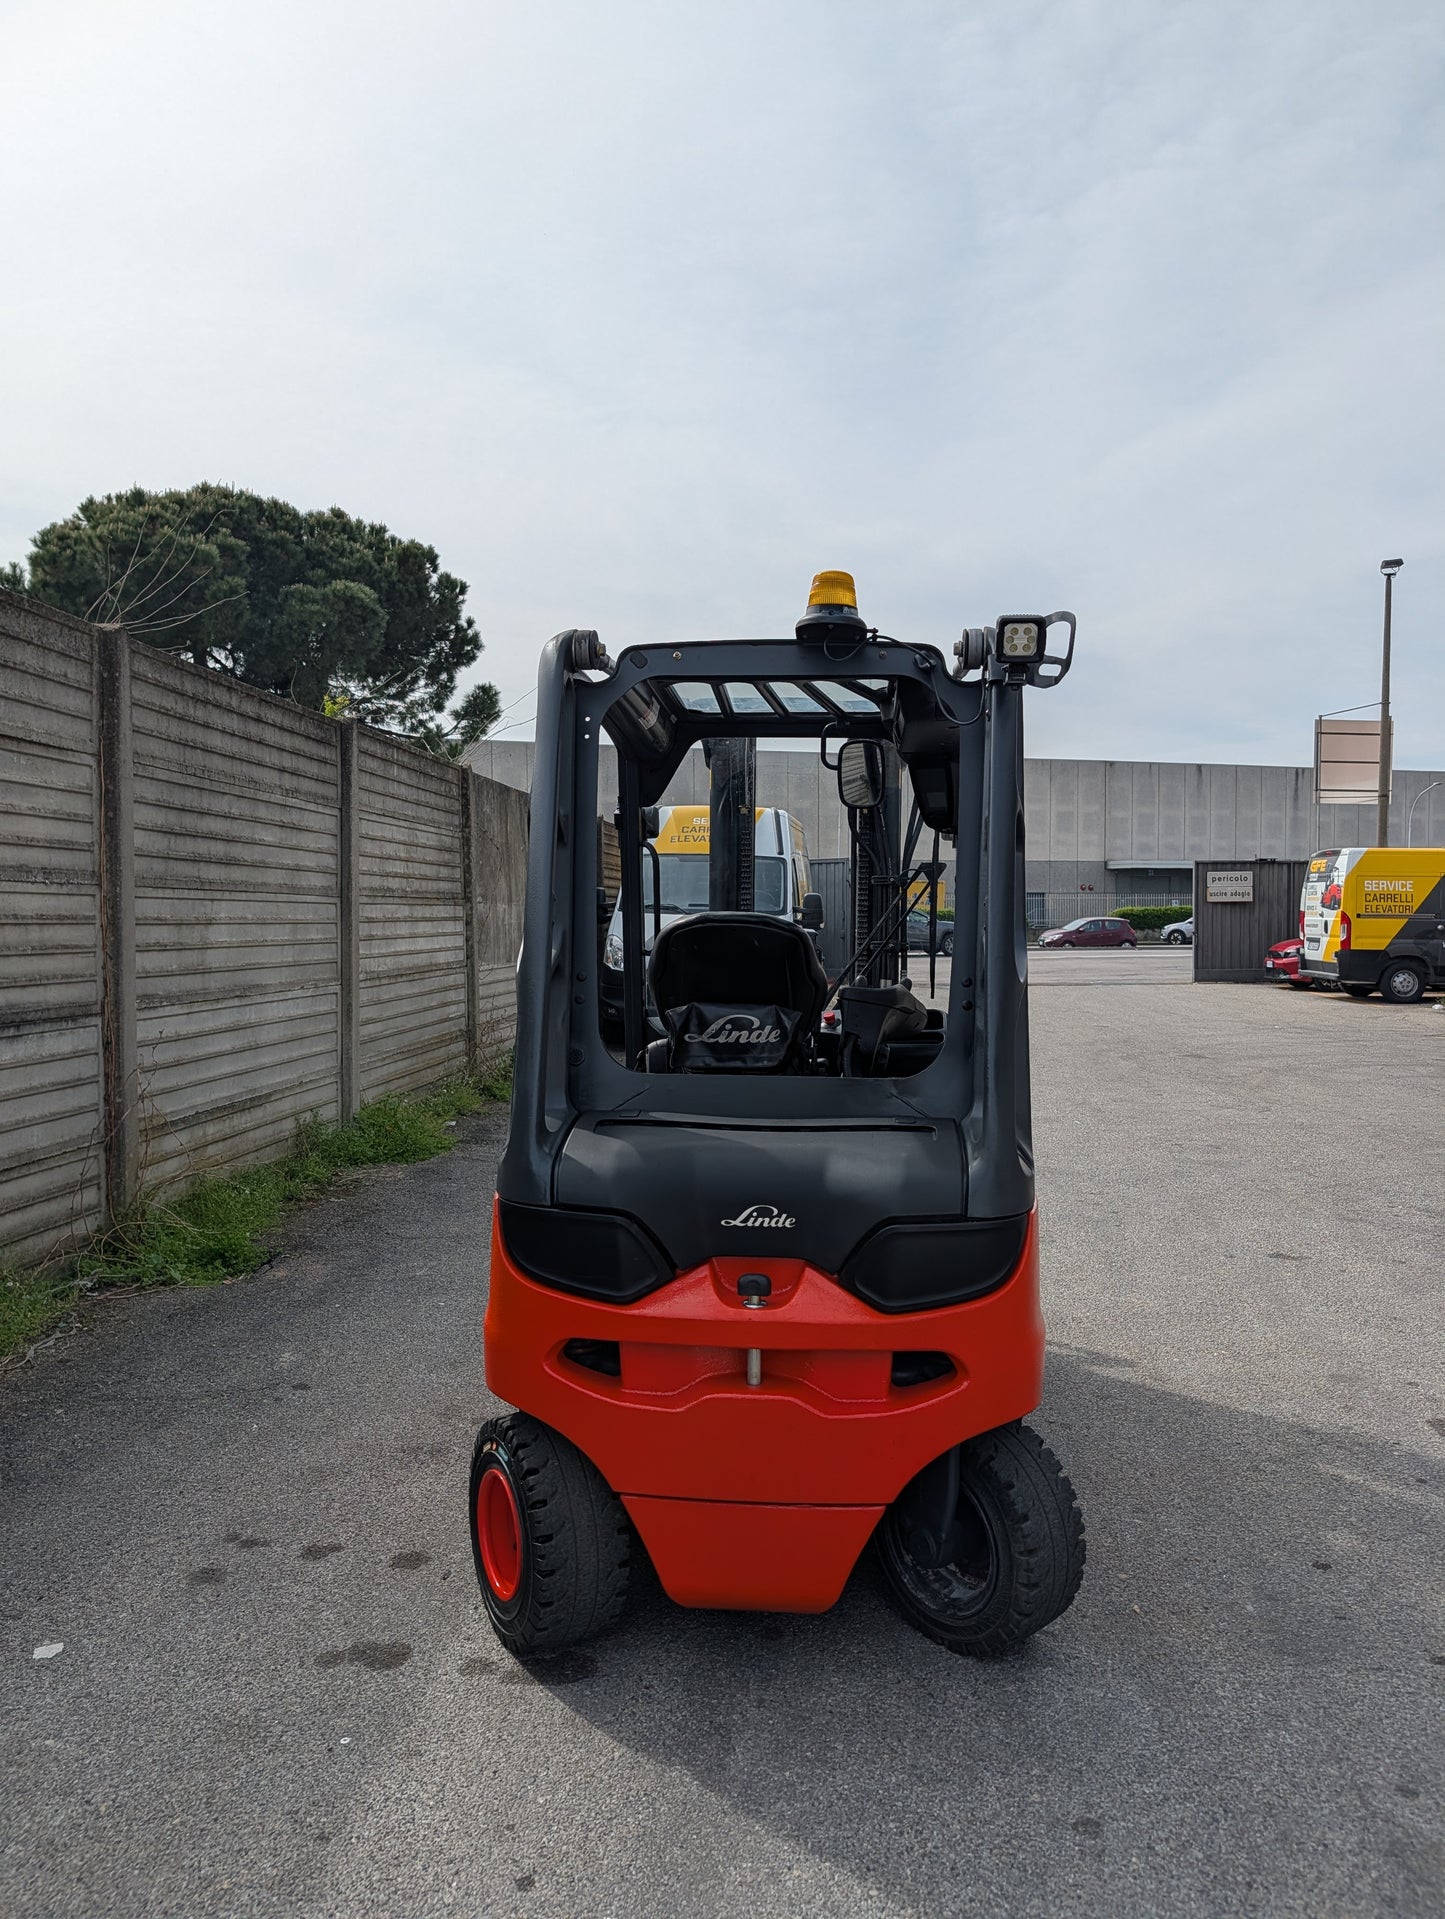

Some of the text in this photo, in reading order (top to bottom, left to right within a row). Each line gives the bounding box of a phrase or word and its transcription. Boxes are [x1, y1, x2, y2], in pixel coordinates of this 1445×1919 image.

[692, 817, 708, 825] SE
[1310, 859, 1327, 873] GFE
[1211, 875, 1249, 883] pericolo
[1364, 880, 1414, 892] SERVICE
[1230, 890, 1251, 898] adagio
[1364, 893, 1414, 903] CARRELLI
[1364, 904, 1414, 914] ELEVATORI
[684, 1014, 781, 1044] Linde
[720, 1204, 796, 1228] Linde
